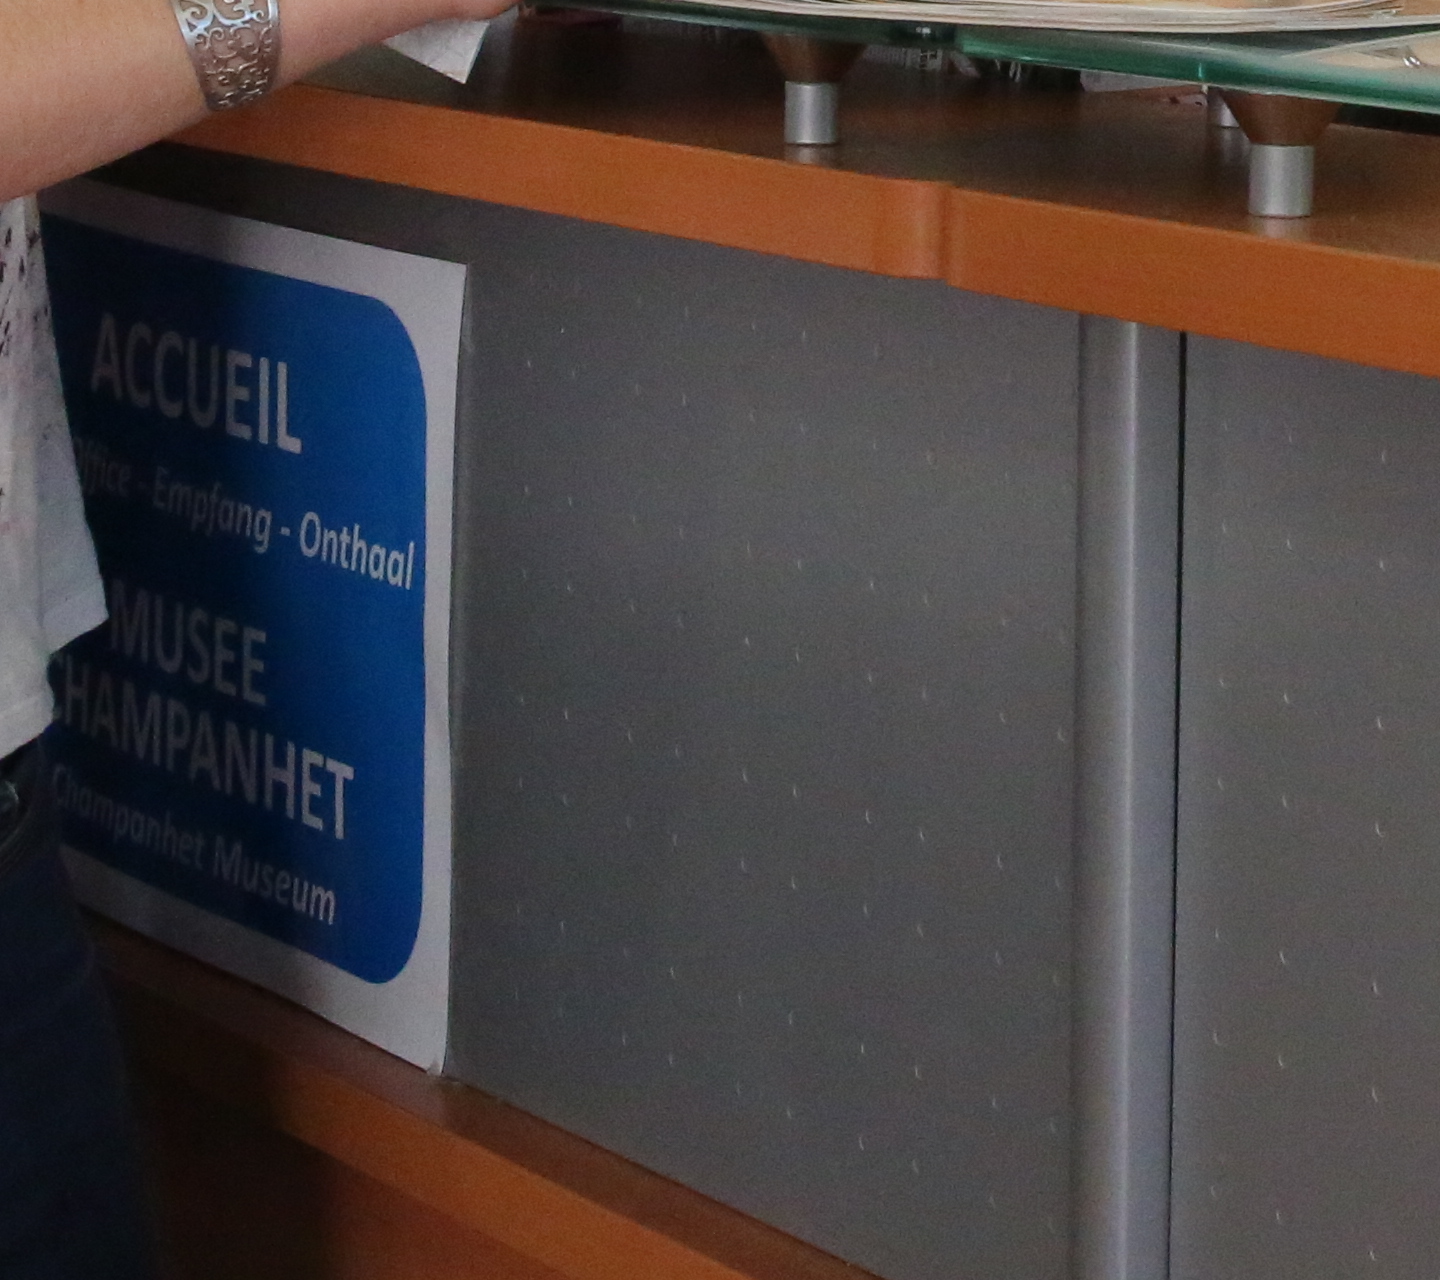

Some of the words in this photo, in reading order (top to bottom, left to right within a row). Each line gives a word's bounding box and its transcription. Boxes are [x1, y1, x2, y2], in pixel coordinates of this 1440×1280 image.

[90, 311, 302, 455] ACCUEIL
[152, 466, 272, 554] Empfang
[298, 509, 416, 592] Onthaal
[110, 578, 267, 707] MUSEE
[51, 762, 203, 871] Champanhet
[212, 833, 336, 926] Museum
